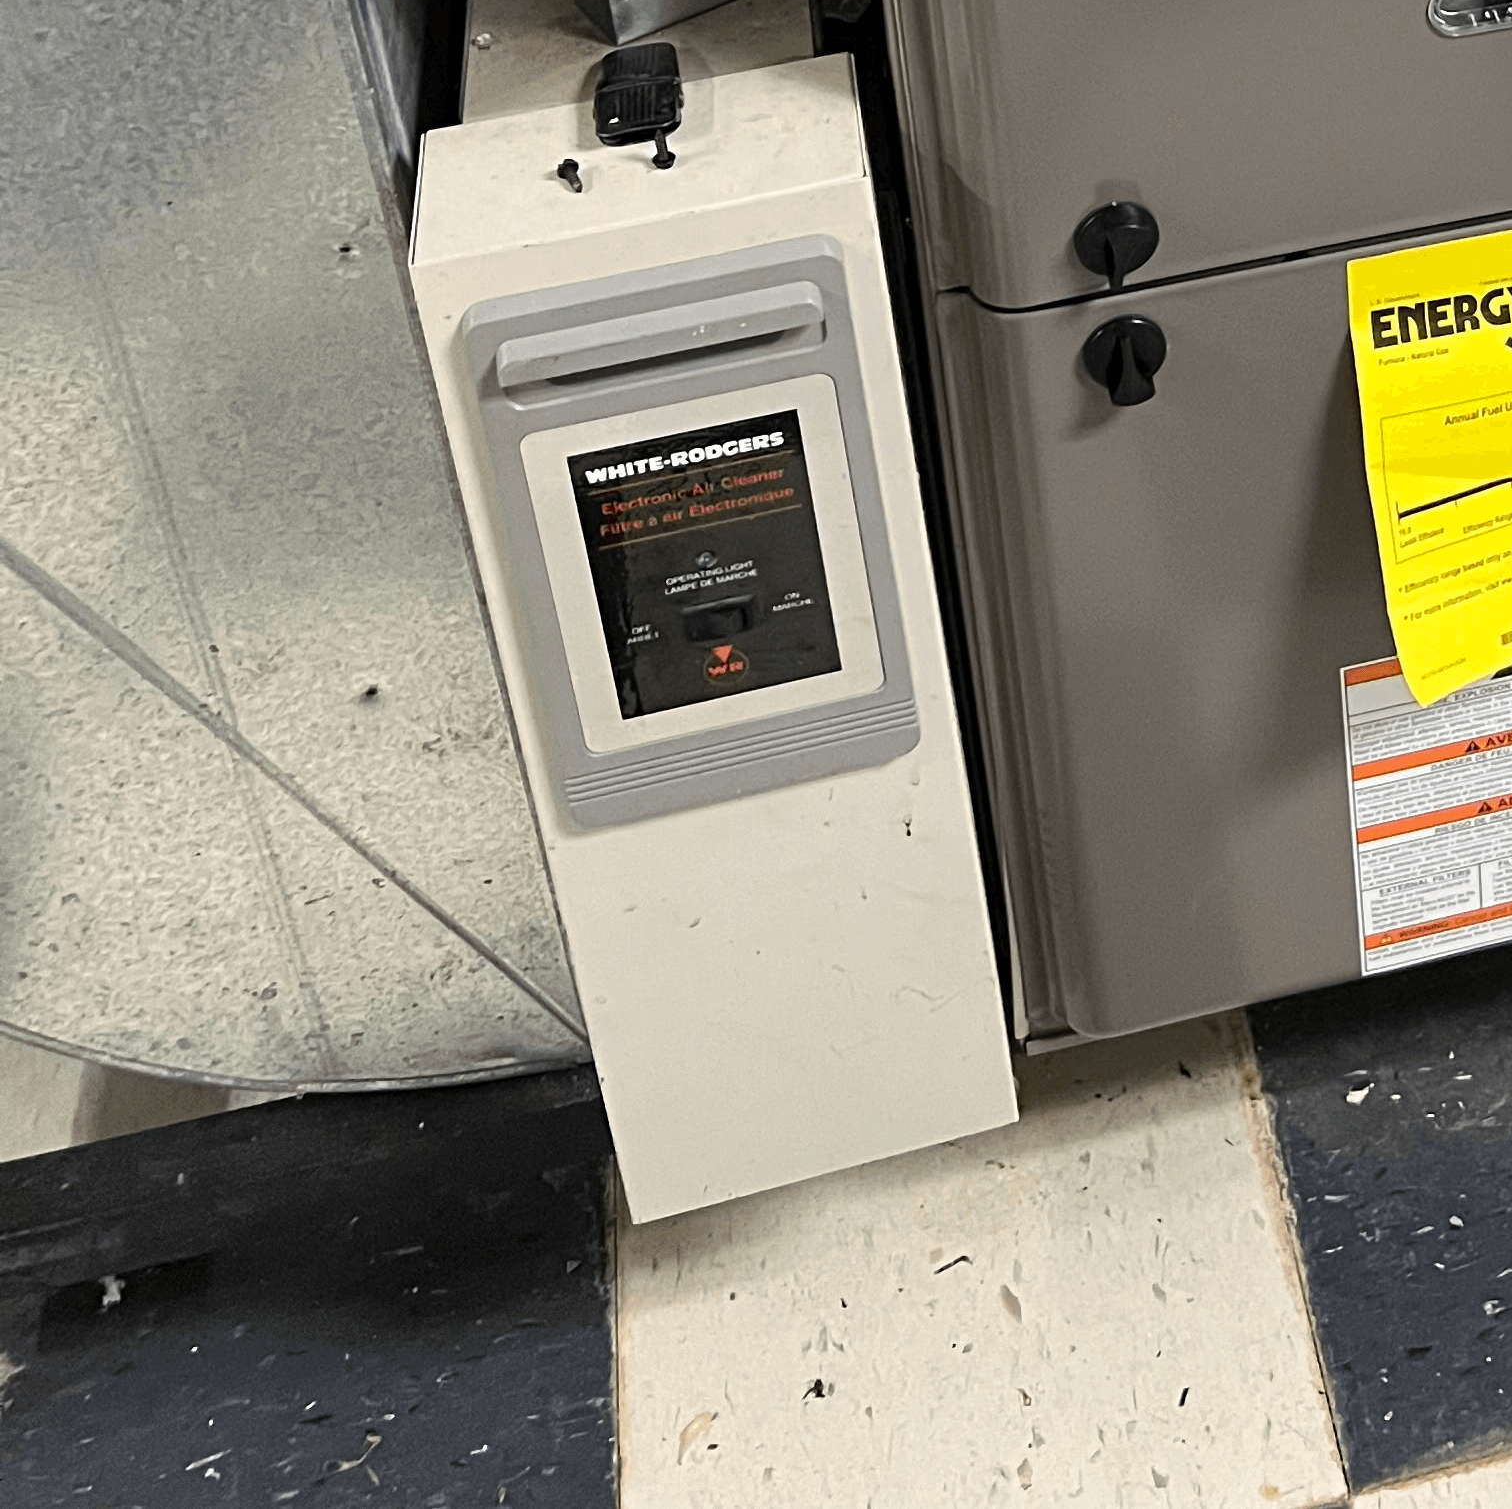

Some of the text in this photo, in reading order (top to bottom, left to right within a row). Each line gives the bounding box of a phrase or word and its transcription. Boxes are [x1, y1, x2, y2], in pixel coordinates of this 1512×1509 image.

[1444, 410, 1480, 426] Annual
[1482, 404, 1503, 417] Fuel
[585, 431, 786, 484] WHITE-RODGERS
[601, 468, 785, 515] Electronic Air Cleaner
[600, 519, 644, 537] Filtre
[662, 511, 684, 523] air
[664, 567, 759, 596] LAMPE DE MARCHE
[665, 559, 755, 586] OPERATING LIGHT
[783, 592, 801, 602] ON
[631, 624, 652, 636] OFF
[1454, 682, 1512, 701] EXPLOSION
[1430, 756, 1473, 772] DANGER
[1474, 752, 1488, 763] DE
